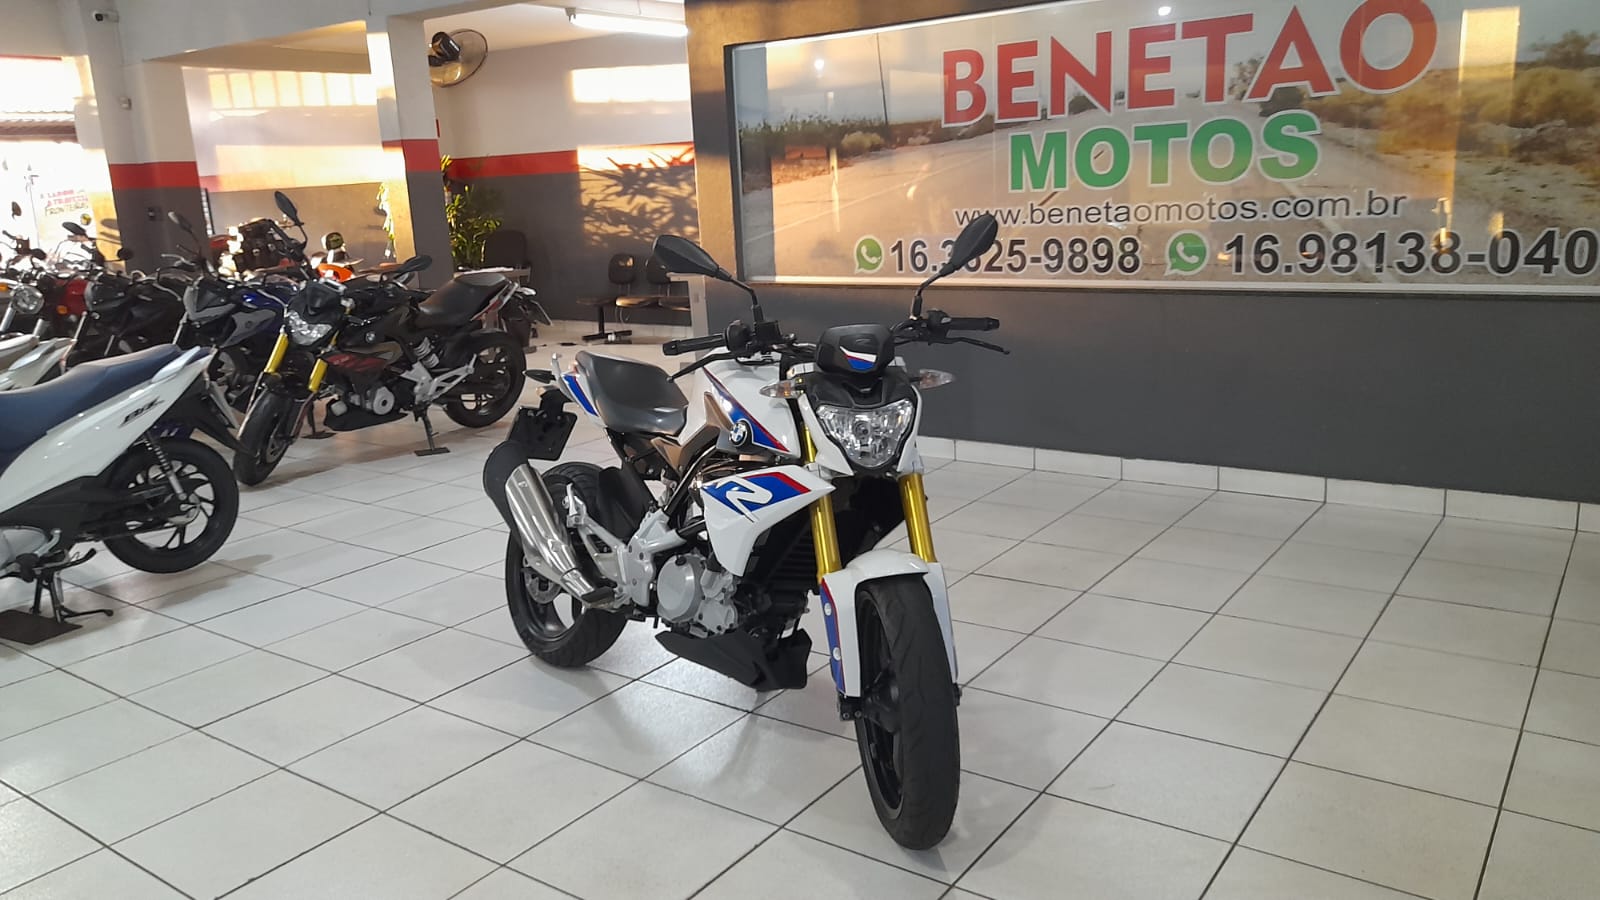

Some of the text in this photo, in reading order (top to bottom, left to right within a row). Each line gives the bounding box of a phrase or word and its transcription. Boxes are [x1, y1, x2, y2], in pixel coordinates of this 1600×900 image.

[941, 0, 1438, 126] BENETAO
[1009, 112, 1320, 191] MOTOS
[1224, 230, 1599, 274] 16.98138-040
